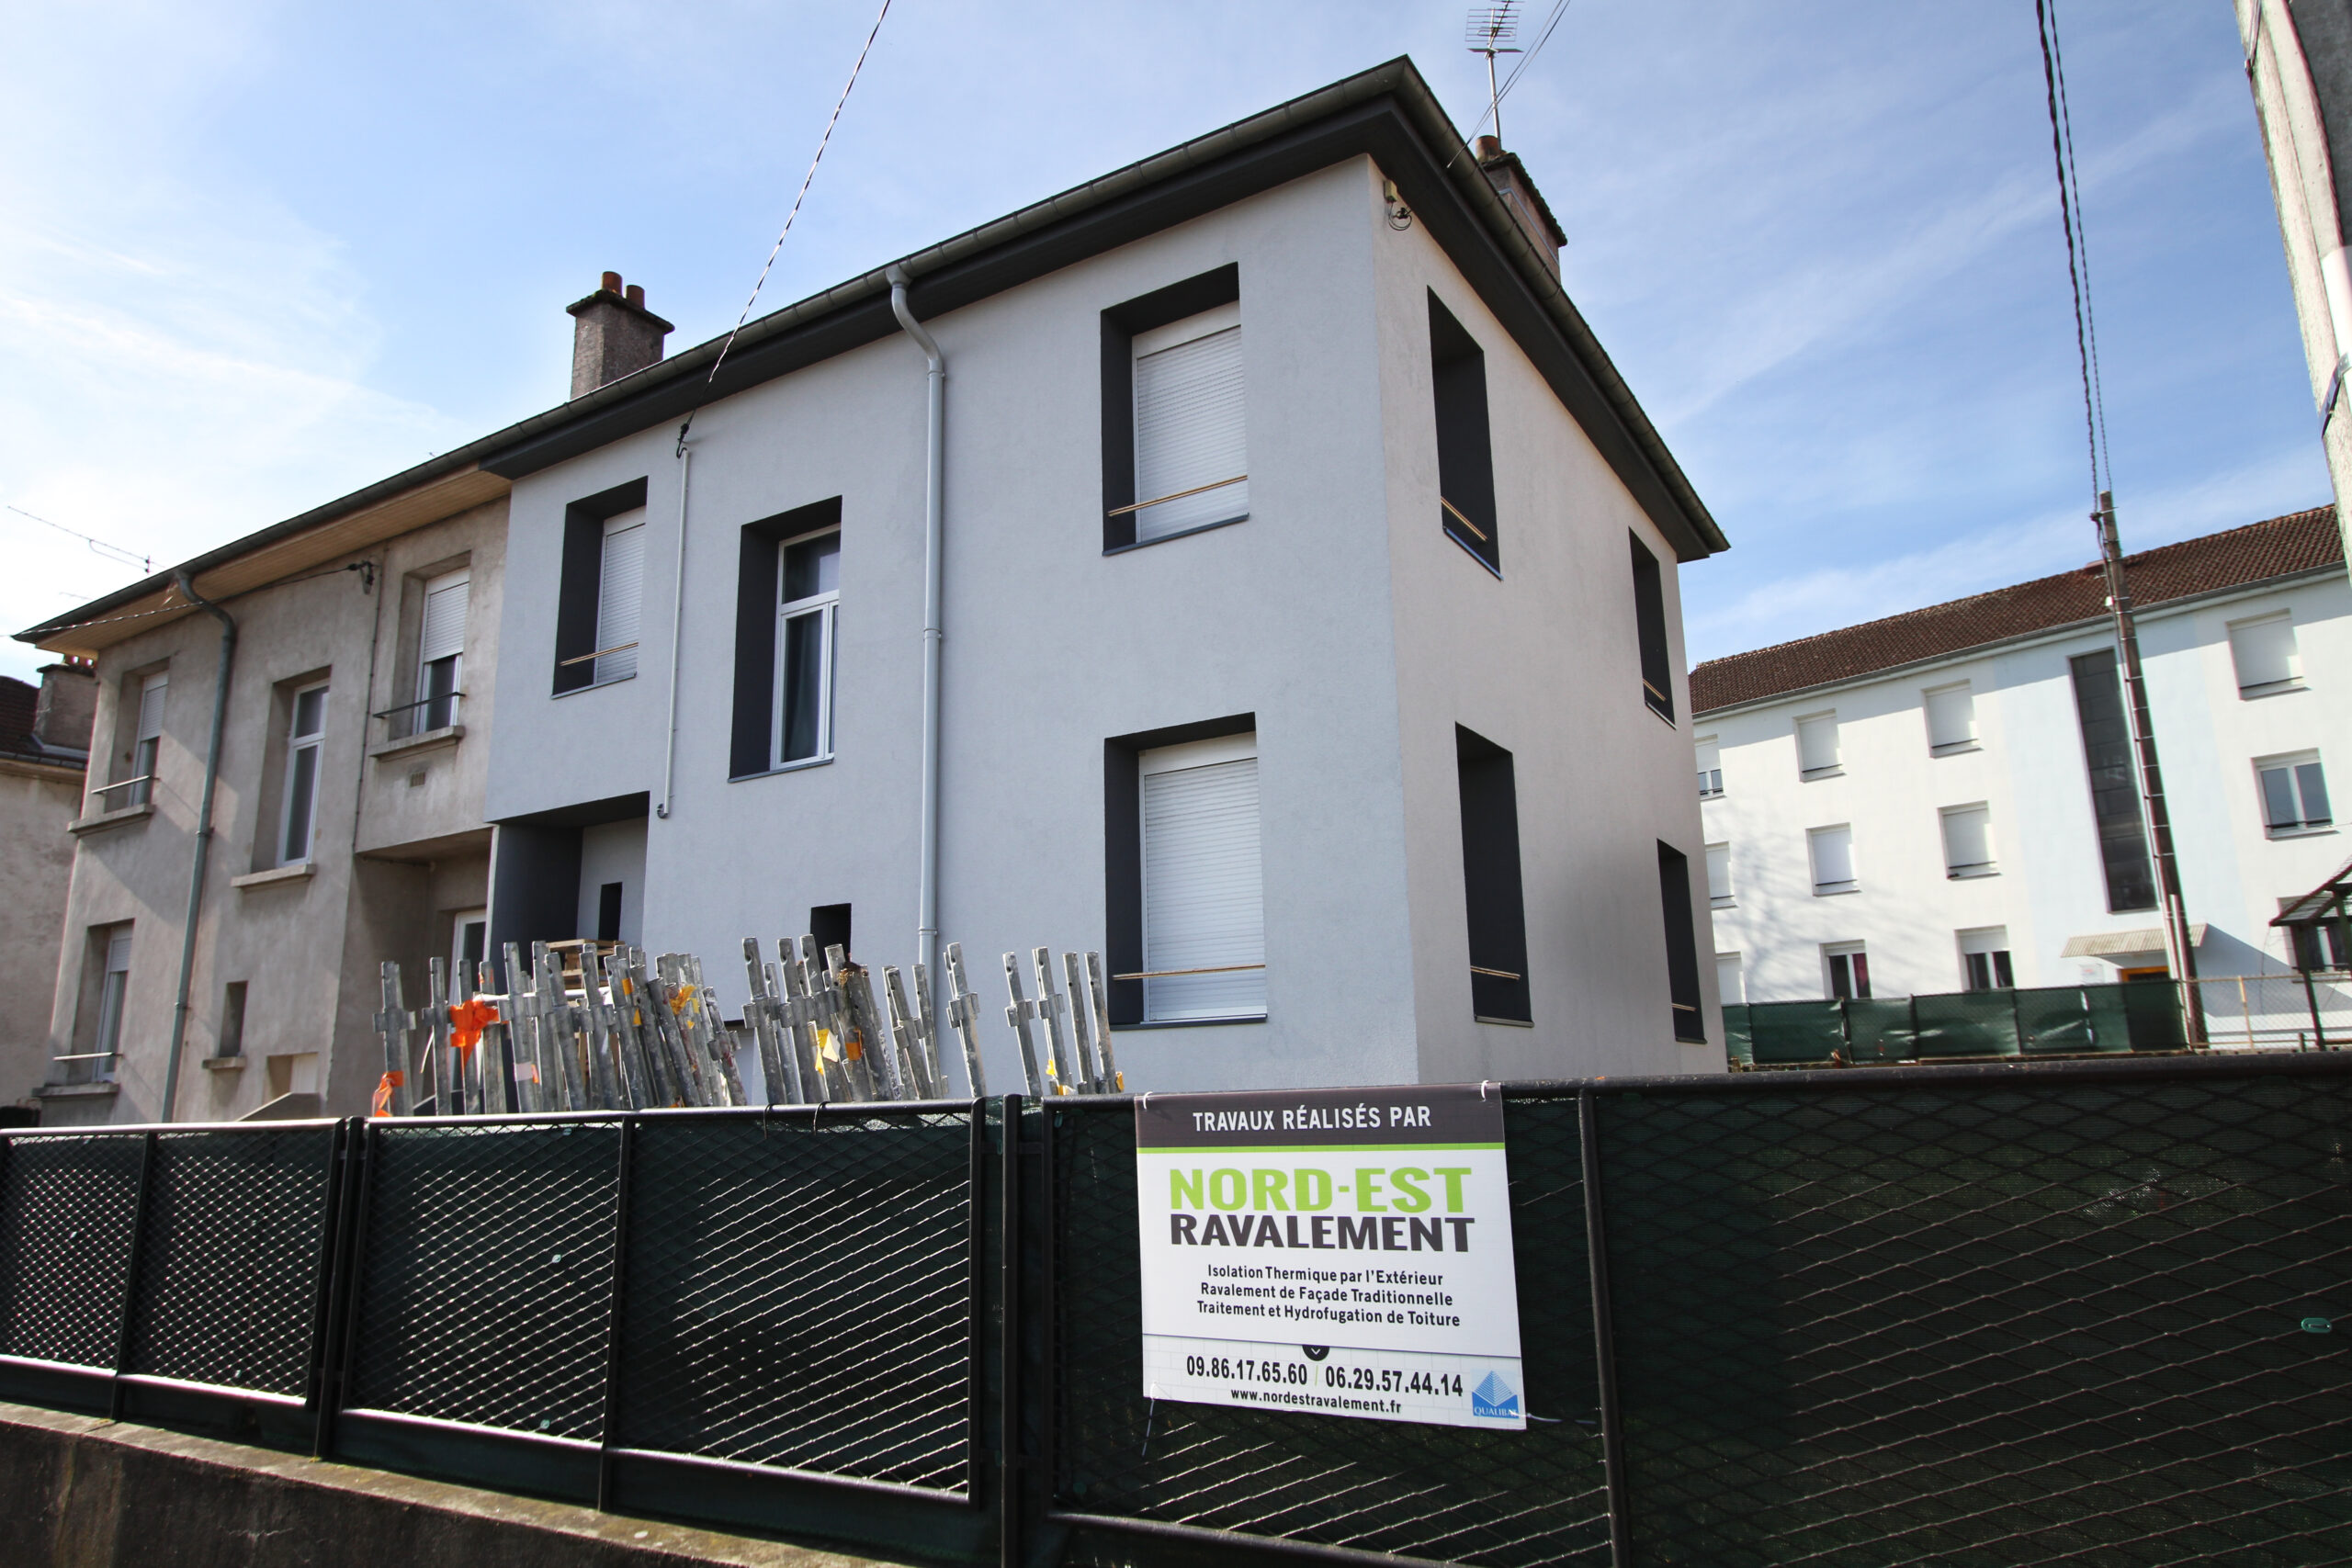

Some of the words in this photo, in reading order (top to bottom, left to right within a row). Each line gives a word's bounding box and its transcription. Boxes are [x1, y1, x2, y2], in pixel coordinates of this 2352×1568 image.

[1193, 1111, 1274, 1131] TRAVAUX
[1283, 1103, 1380, 1129] RÉALISÉS
[1390, 1106, 1430, 1126] PAR
[1170, 1168, 1471, 1213] NORD-EST
[1171, 1214, 1475, 1252] RAVALEMENT
[1209, 1265, 1262, 1278] Isolation
[1265, 1267, 1336, 1283] Thermique
[1340, 1272, 1362, 1284] par
[1366, 1270, 1442, 1285] l'Extérieur
[1202, 1282, 1275, 1298] Ravalement
[1280, 1286, 1295, 1298] de
[1300, 1287, 1347, 1303] Façade
[1351, 1289, 1453, 1305] Traditionnelle
[1197, 1301, 1264, 1316] Traitement
[1269, 1305, 1281, 1317] et
[1284, 1304, 1382, 1324] Hydrofugation
[1387, 1311, 1403, 1324] de
[1408, 1311, 1460, 1326] Toiture
[1186, 1355, 1307, 1384] 09.86.17.65.60
[1325, 1366, 1463, 1397] 06.29.57.44.14
[1230, 1387, 1401, 1414] www.nordestravalement.fr
